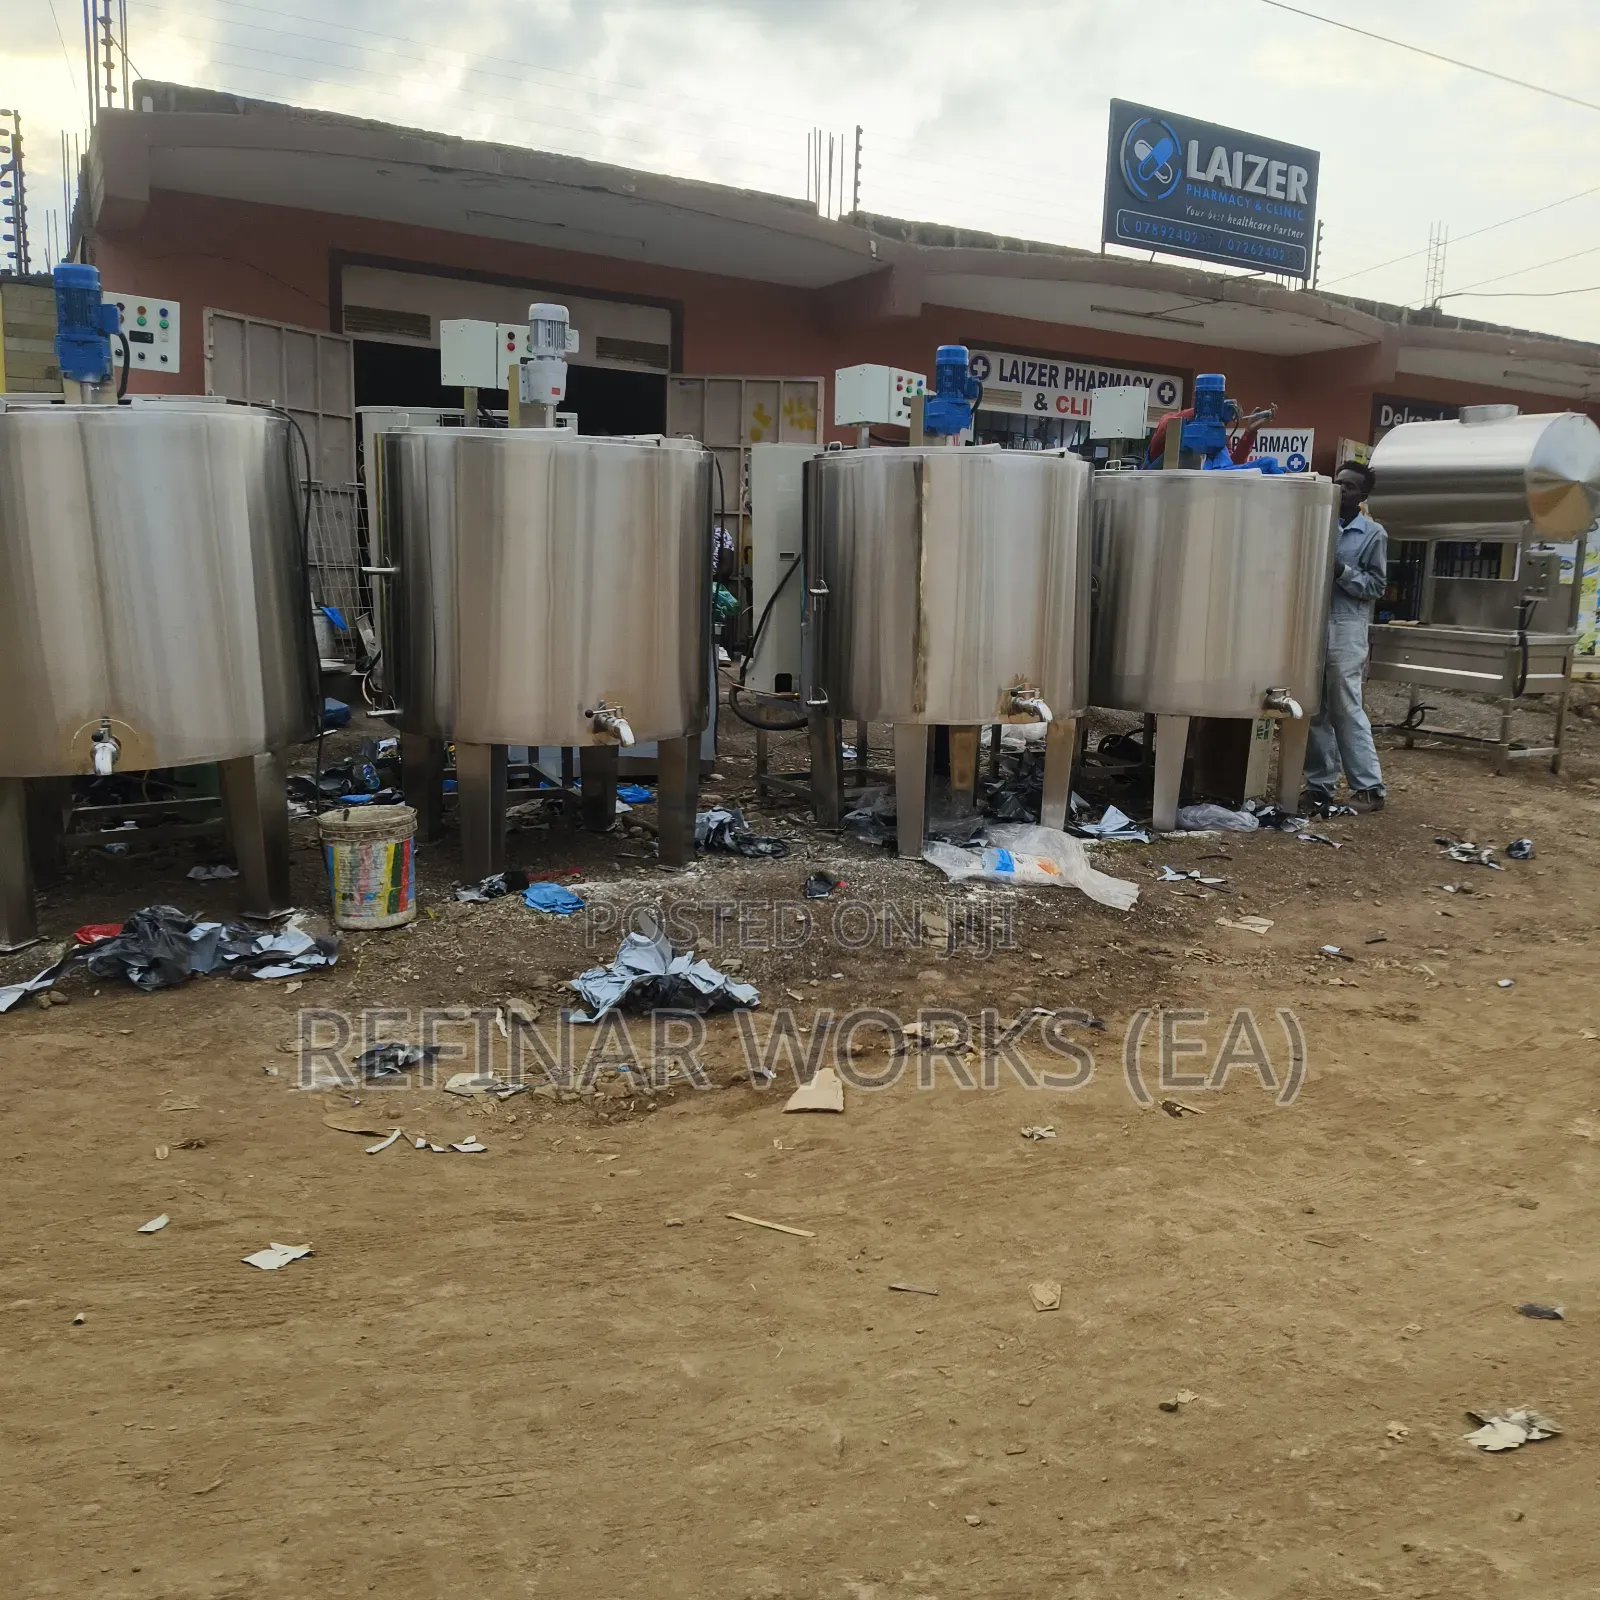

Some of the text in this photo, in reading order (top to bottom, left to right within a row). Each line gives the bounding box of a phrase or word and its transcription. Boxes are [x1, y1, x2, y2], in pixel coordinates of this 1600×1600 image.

[1186, 140, 1308, 205] LAIZER
[1186, 183, 1306, 222] PHARMACY & CLINIC
[1185, 204, 1205, 218] Your
[1227, 213, 1272, 233] healthcare
[1273, 223, 1306, 240] Partner
[998, 358, 1060, 389] LAIZER
[1033, 392, 1093, 417] & CLI
[1232, 436, 1309, 453] PARMACY
